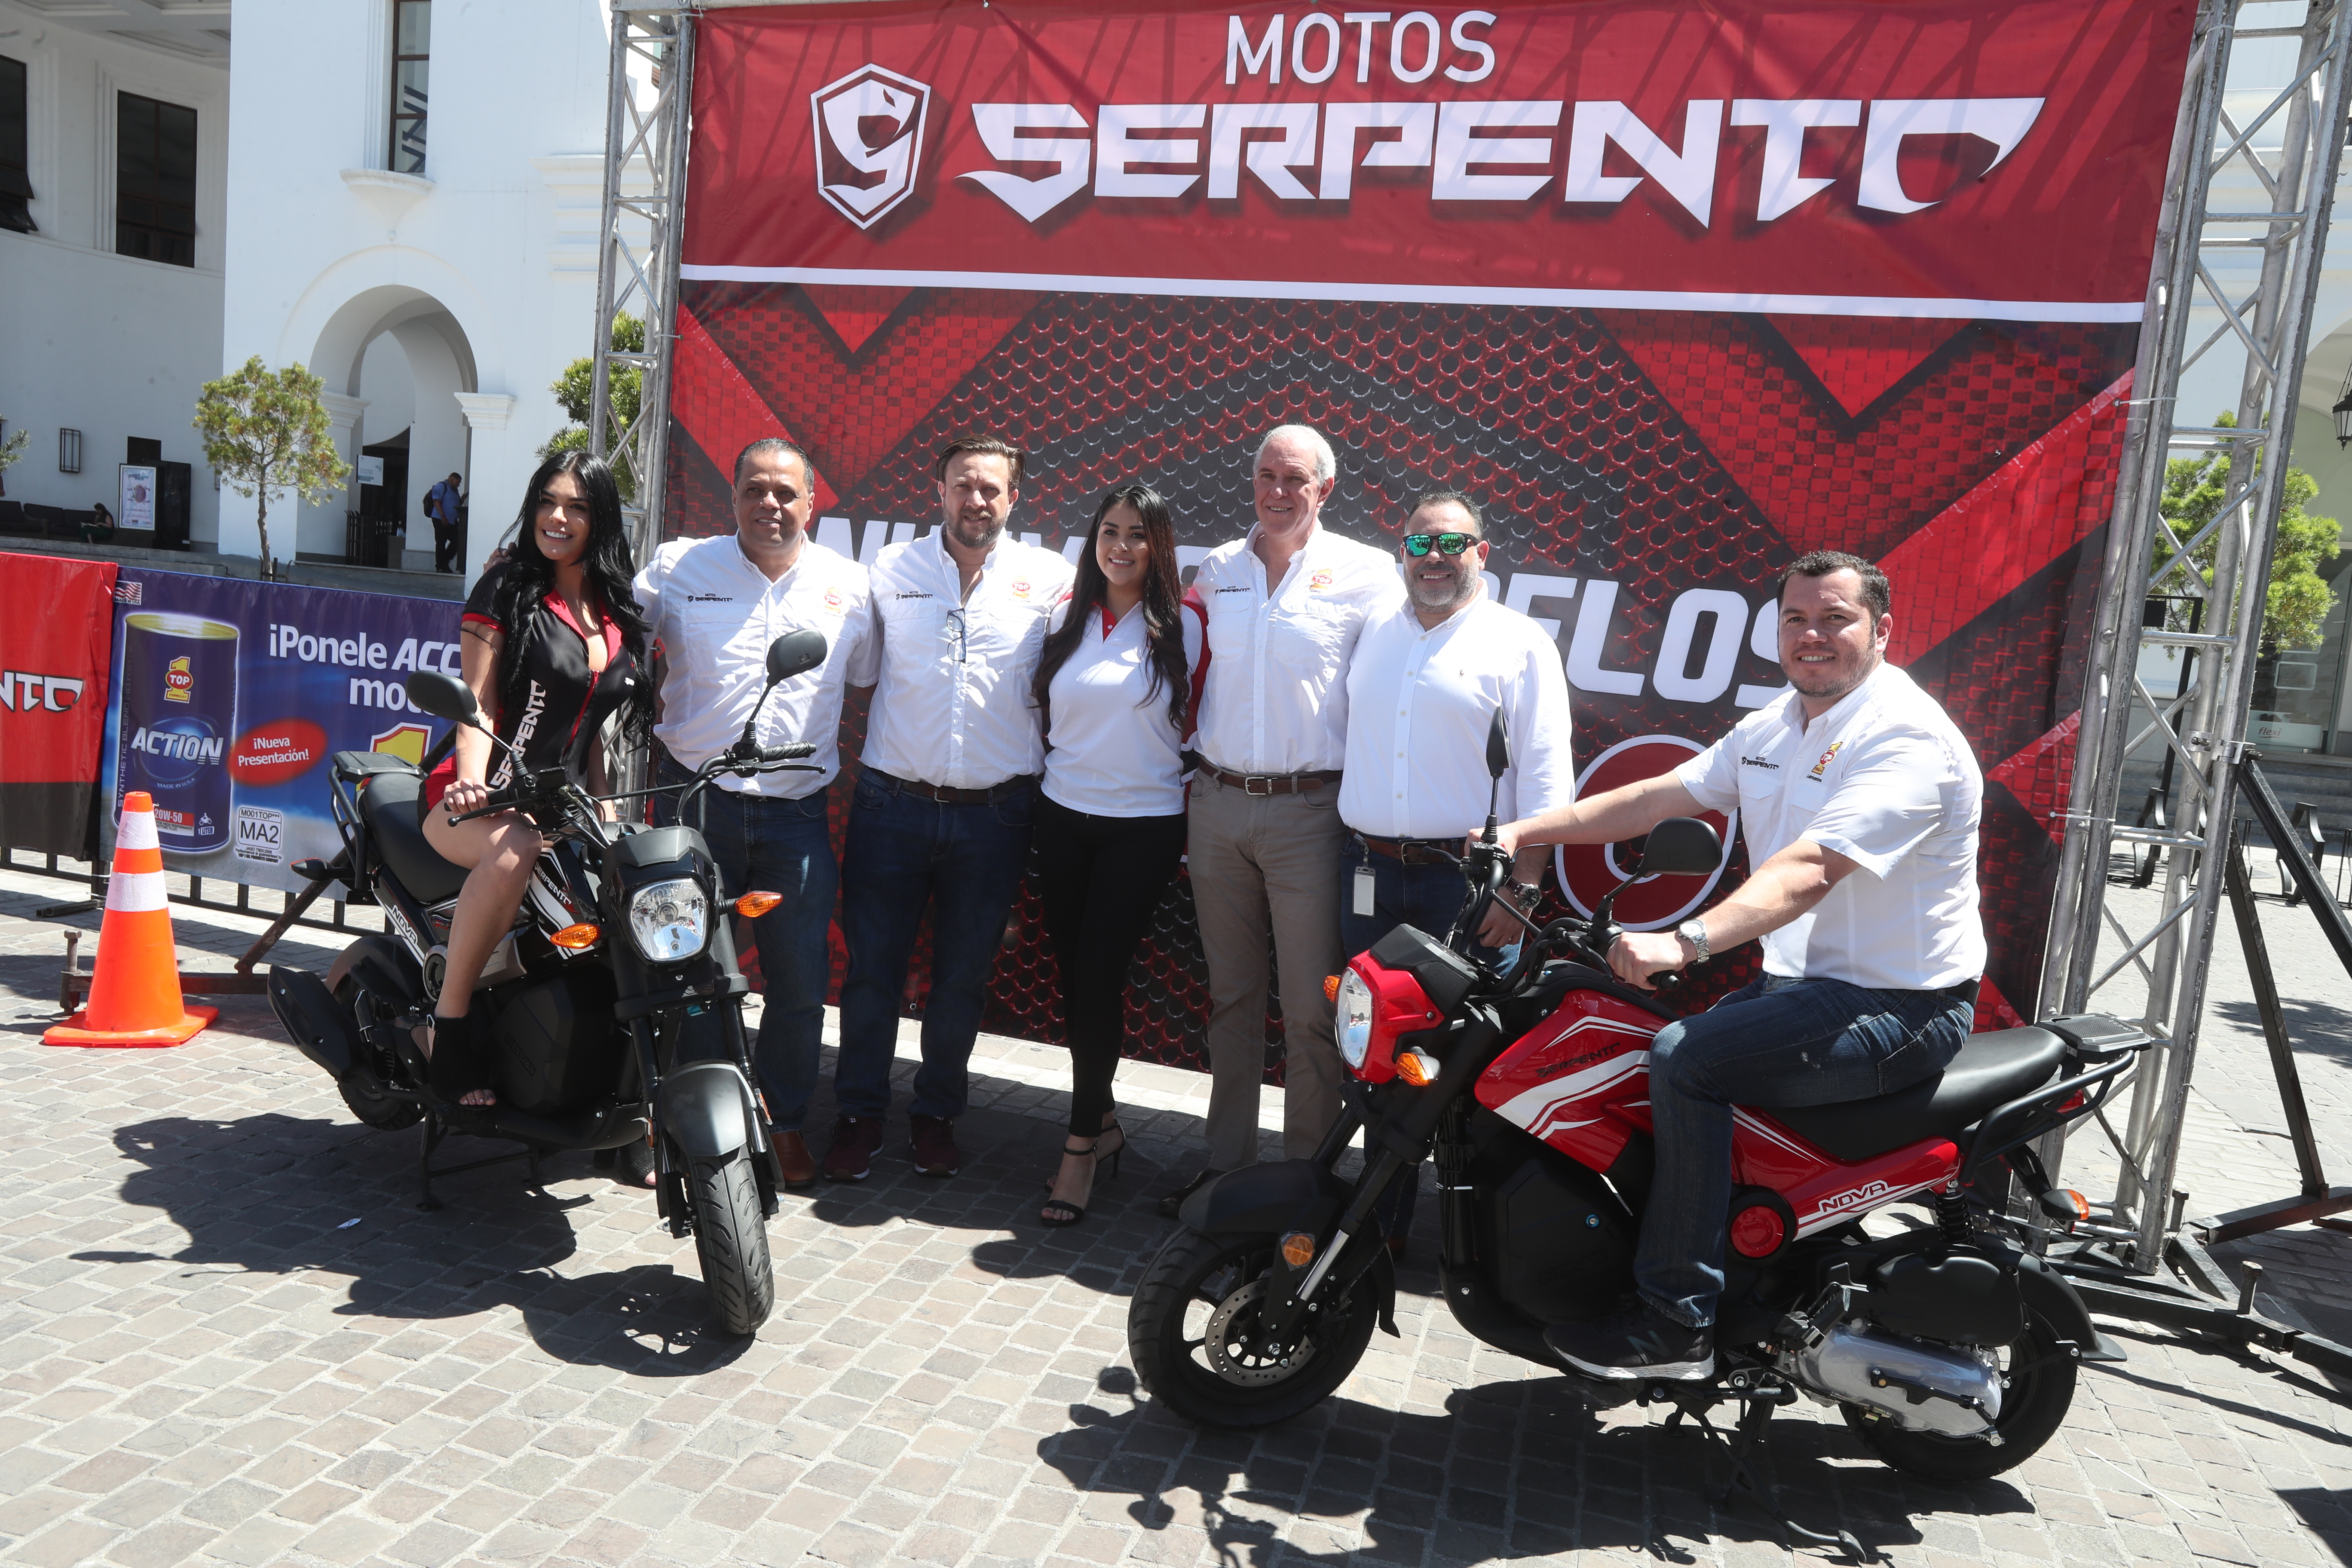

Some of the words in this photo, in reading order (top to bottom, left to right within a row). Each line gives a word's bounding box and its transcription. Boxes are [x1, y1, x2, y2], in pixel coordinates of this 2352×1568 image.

[1225, 10, 1497, 84] MOTOS
[955, 98, 2045, 228] SERPENTO
[826, 595, 840, 603] TOP
[169, 674, 190, 685] TOP
[2258, 727, 2282, 736] flexi
[131, 727, 224, 765] ACTION
[238, 748, 309, 766] Presentación!
[118, 744, 127, 807] SYNTHETIC
[1746, 759, 1779, 769] SERPENTO
[154, 808, 183, 823] 20W-50
[240, 821, 279, 844] MA2
[534, 861, 572, 905] SERPENTO
[392, 905, 417, 945] NOVA
[1821, 1181, 1887, 1213] NOVA
